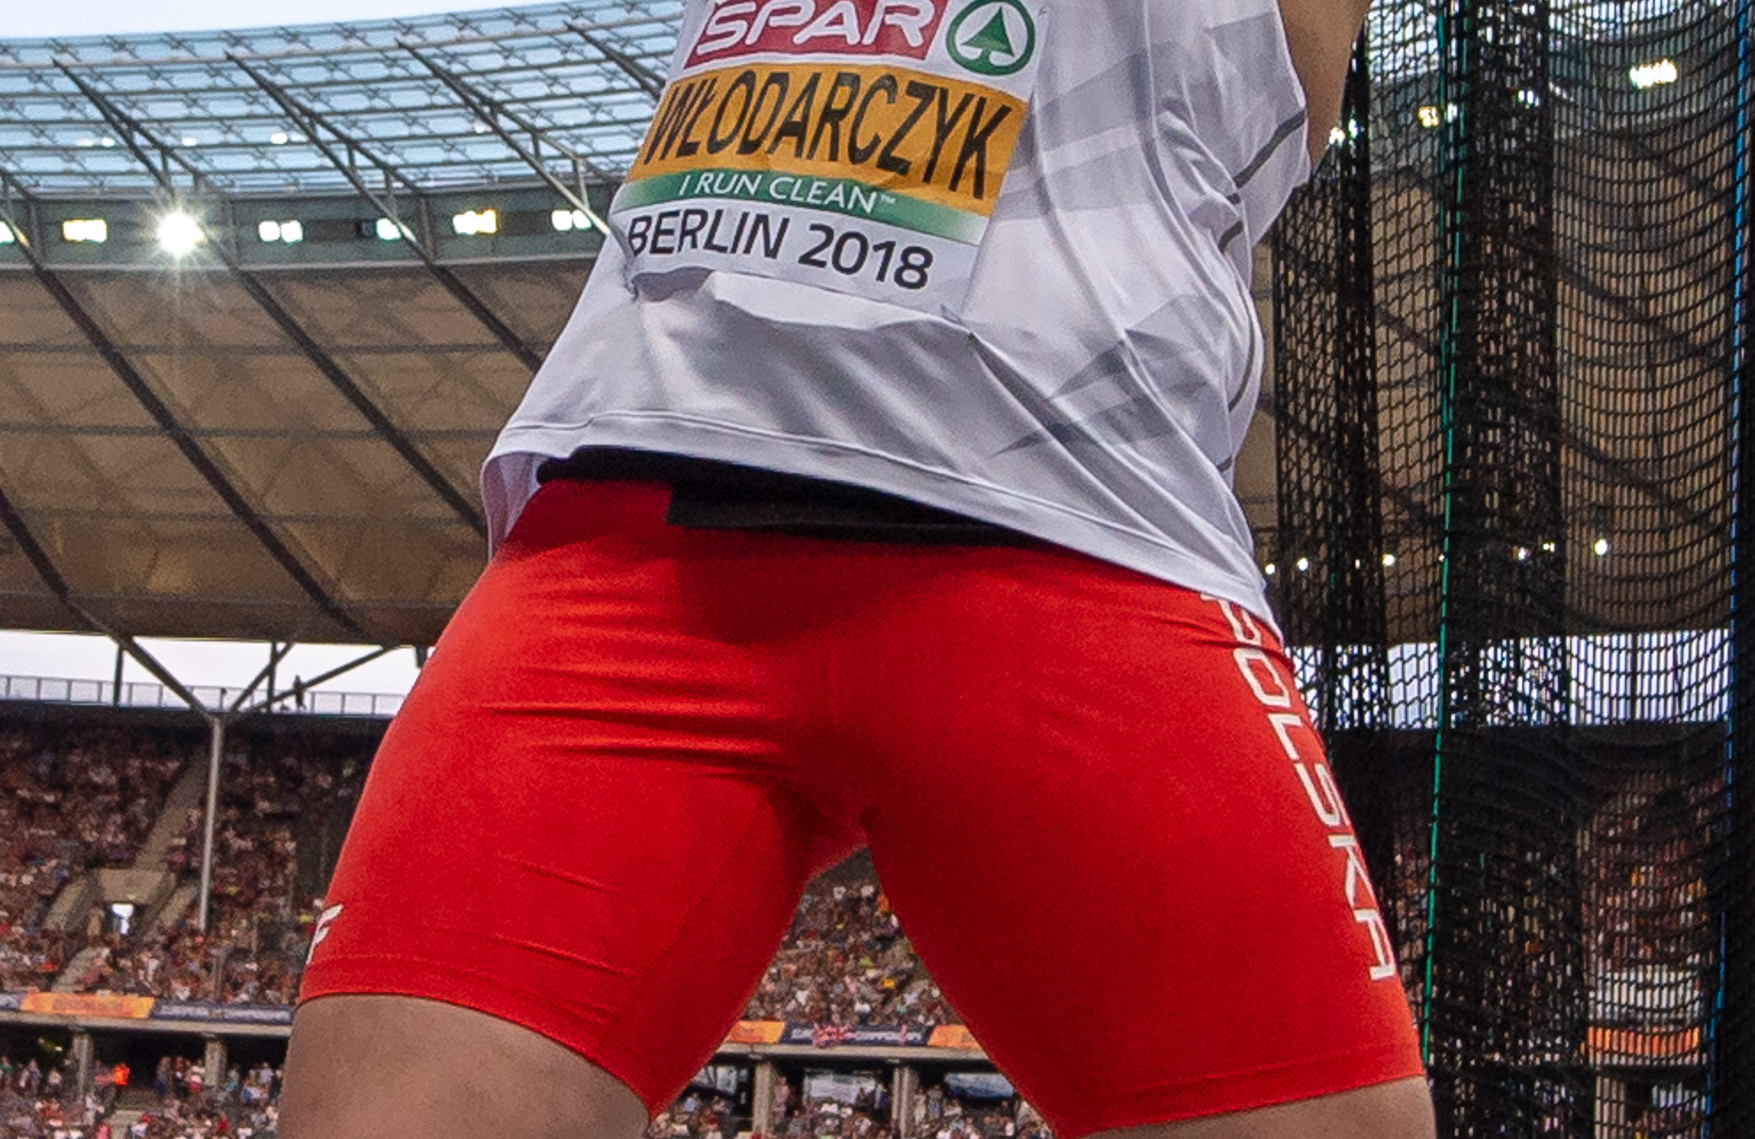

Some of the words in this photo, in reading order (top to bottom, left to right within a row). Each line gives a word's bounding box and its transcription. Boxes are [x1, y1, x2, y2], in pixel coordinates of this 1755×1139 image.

[643, 68, 1013, 200] WŁODARCZYK
[678, 174, 692, 196] I
[695, 171, 763, 197] RUN
[627, 208, 790, 260] BERLIN
[798, 222, 935, 290] 2018
